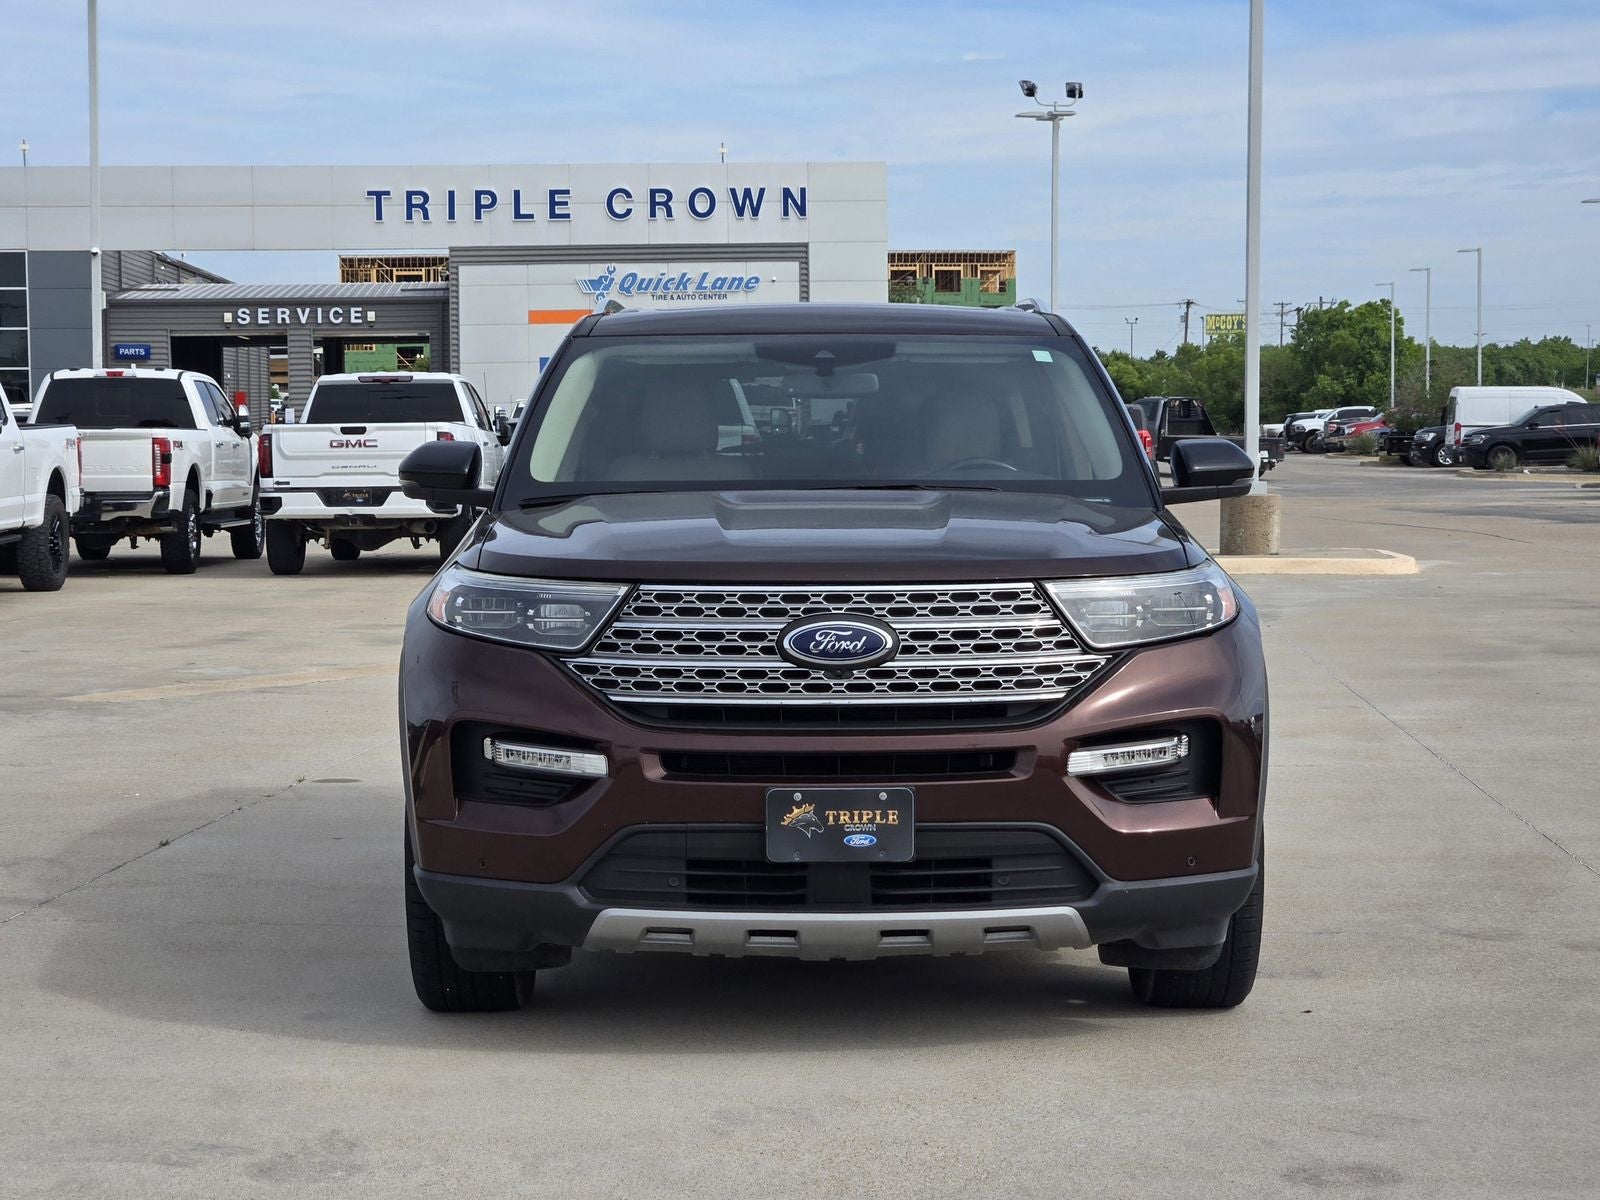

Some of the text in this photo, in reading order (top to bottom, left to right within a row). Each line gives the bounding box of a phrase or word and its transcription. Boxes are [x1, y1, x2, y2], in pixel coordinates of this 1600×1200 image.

[366, 186, 808, 222] TRIPLE CROWN
[618, 271, 761, 296] Quick Lane
[676, 293, 696, 301] AUTO
[237, 307, 363, 325] SERVICE
[329, 439, 378, 449] GMC
[809, 629, 867, 654] Ford
[825, 810, 899, 825] TRIPLE
[844, 823, 877, 832] CROWN
[849, 836, 871, 845] Ford
